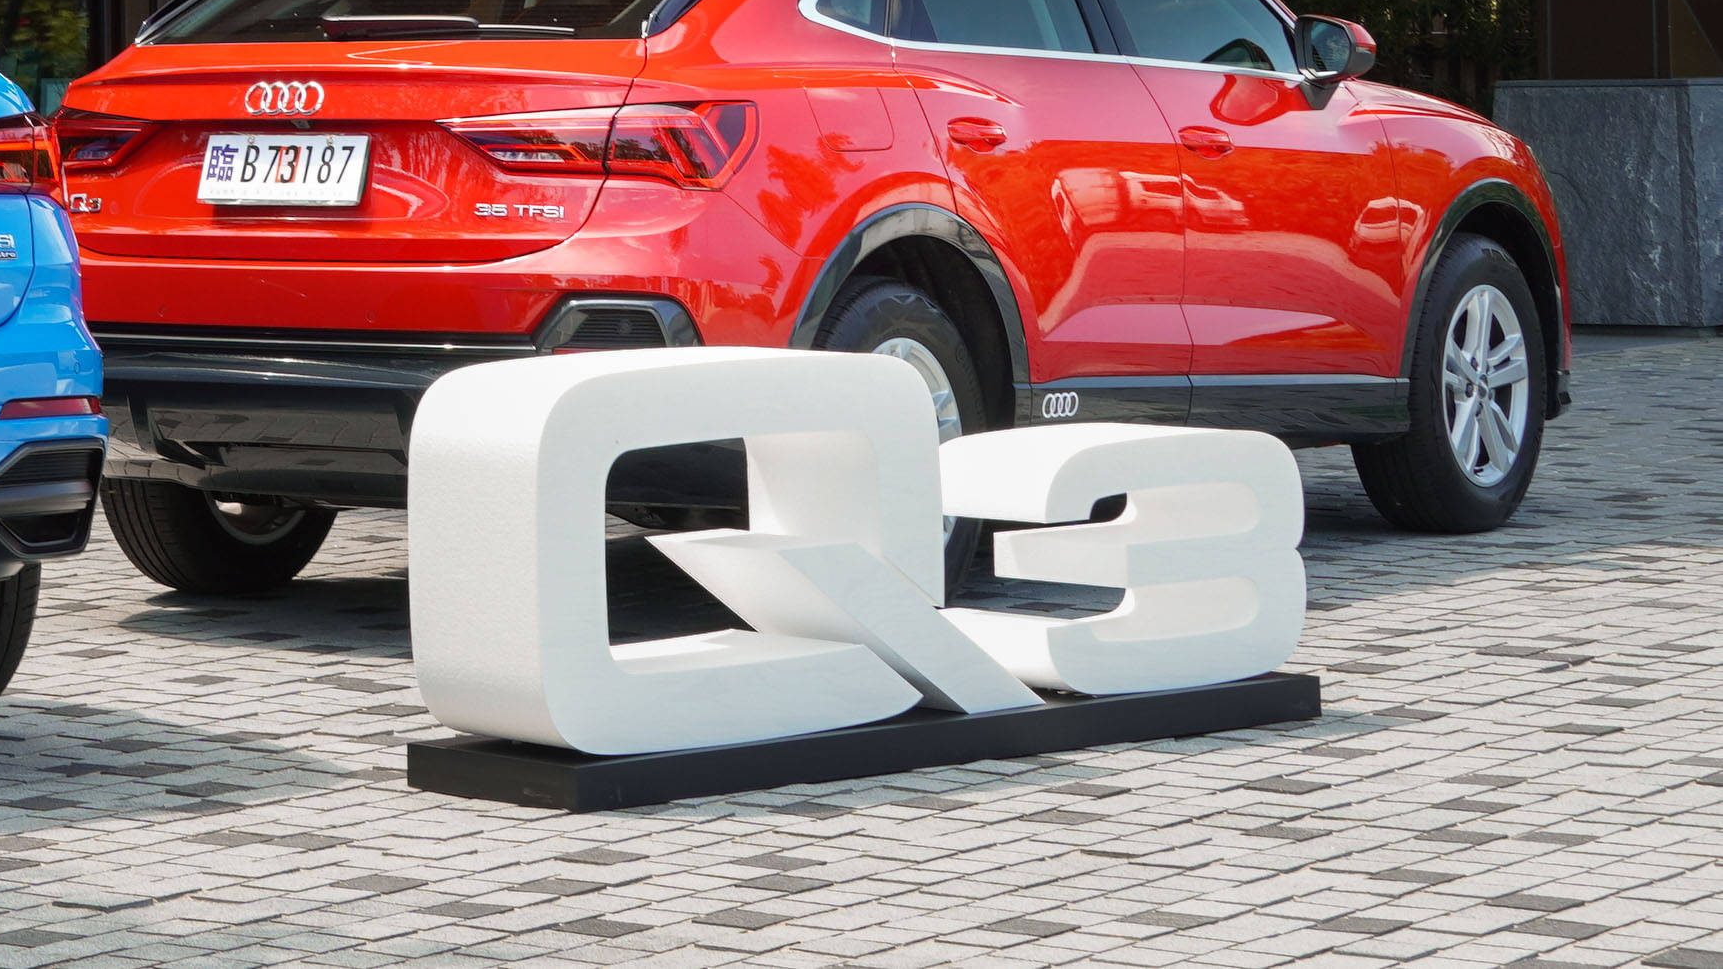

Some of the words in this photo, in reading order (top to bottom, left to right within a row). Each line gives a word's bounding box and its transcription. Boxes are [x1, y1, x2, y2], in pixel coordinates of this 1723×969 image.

[474, 203, 508, 217] 35
[513, 204, 565, 219] TFSI
[407, 346, 1306, 756] Q3
